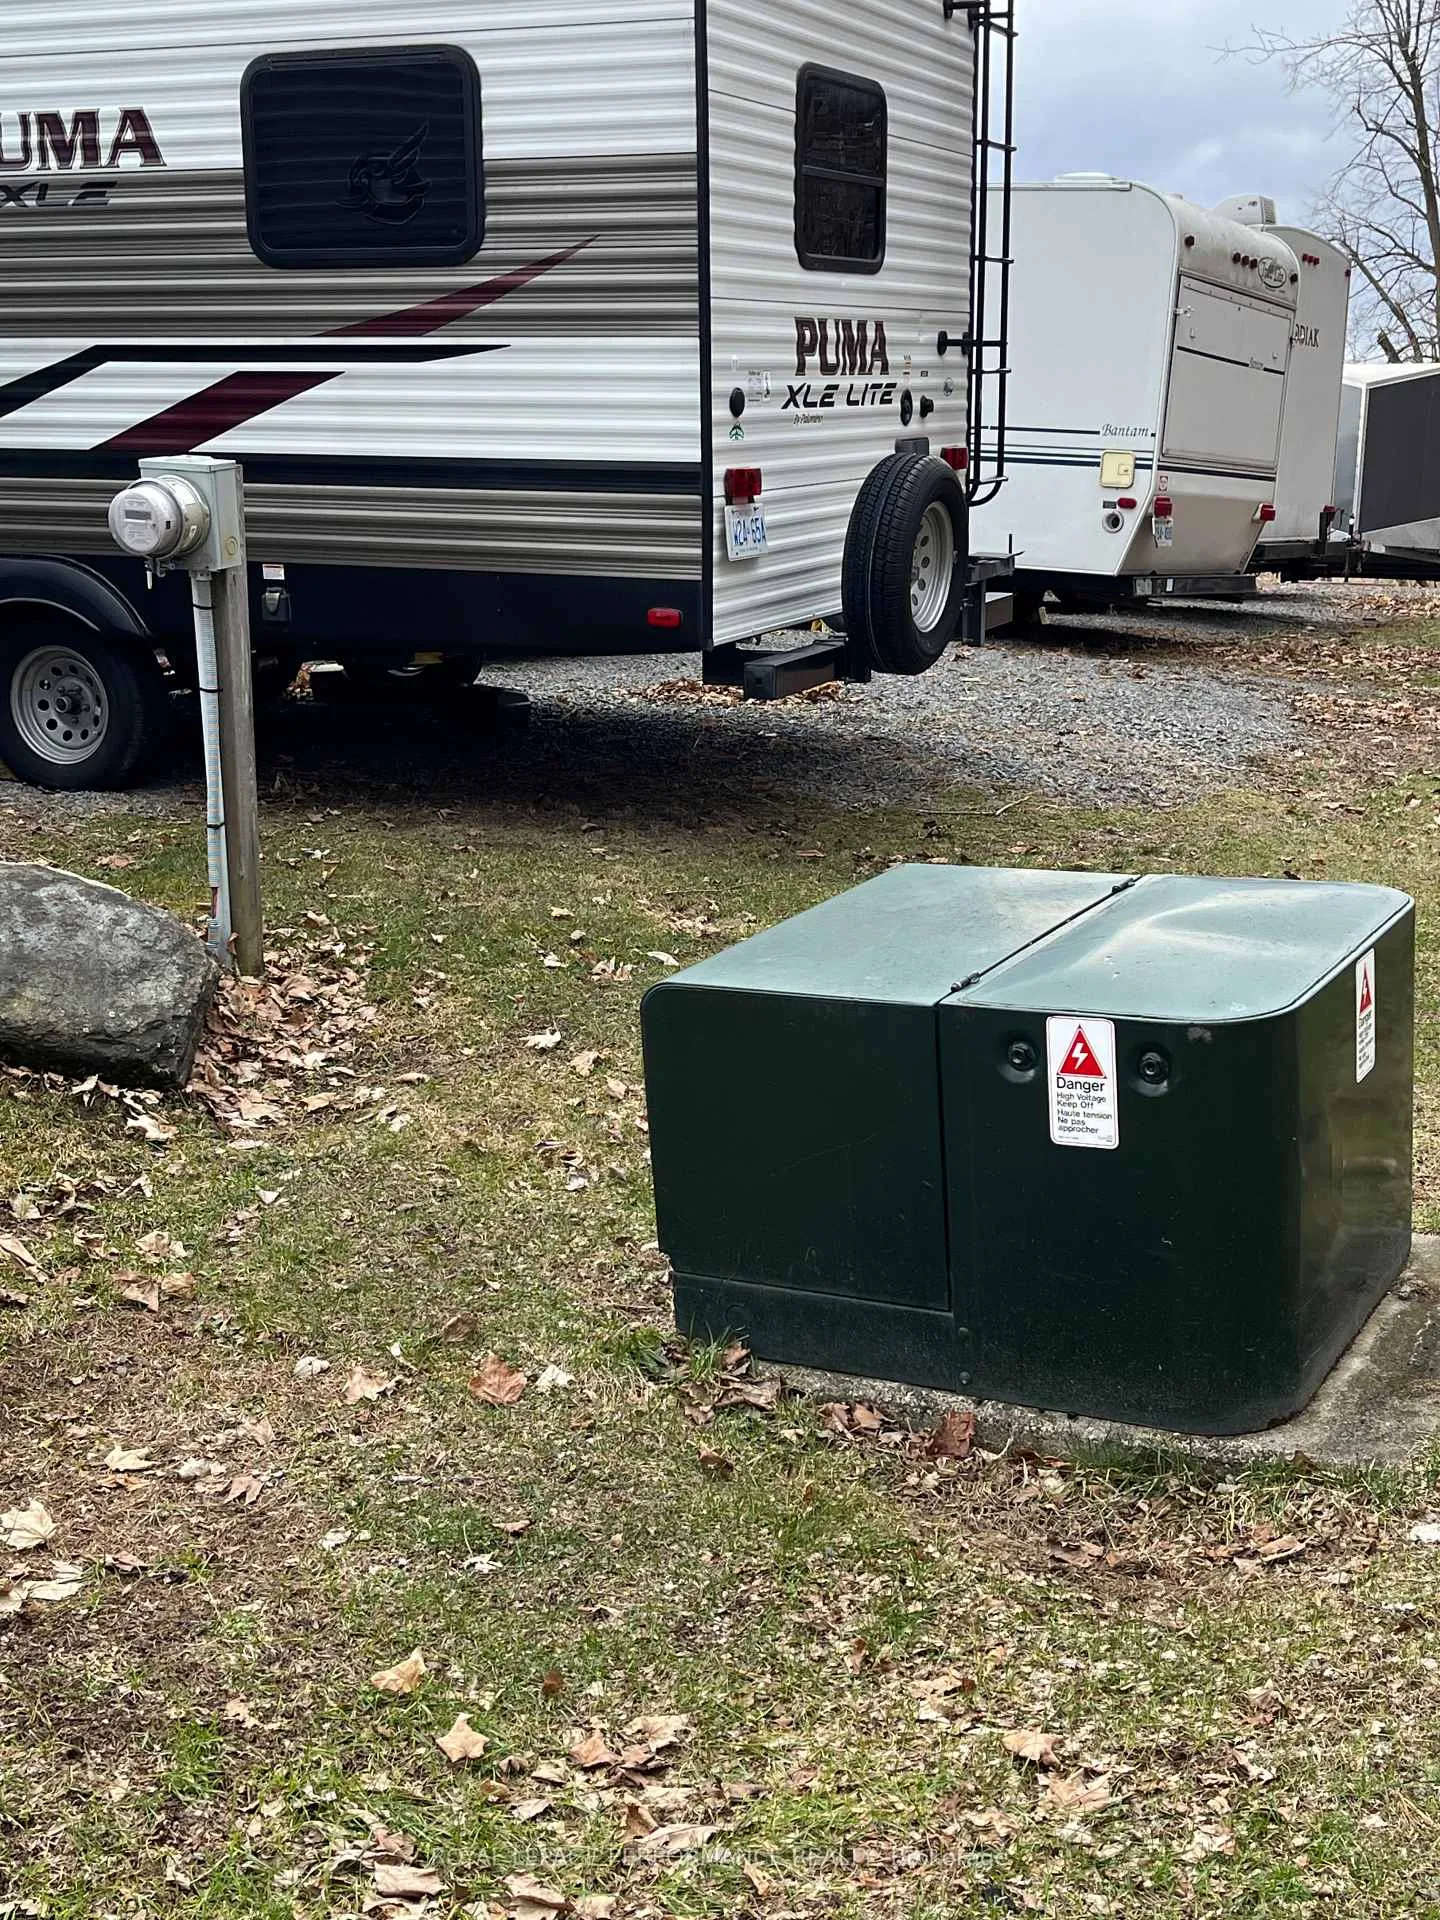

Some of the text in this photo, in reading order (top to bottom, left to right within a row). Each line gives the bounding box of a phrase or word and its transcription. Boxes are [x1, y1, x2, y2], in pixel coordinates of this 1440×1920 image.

[793, 316, 889, 376] PUMA
[781, 382, 840, 410] XLE
[846, 382, 898, 407] LITE
[1101, 423, 1149, 438] Bantam
[1056, 1077, 1105, 1093] Danger
[1057, 1092, 1106, 1103] High Voltage
[1057, 1100, 1094, 1109] Keep Off
[1057, 1109, 1113, 1120] Haute tension
[1071, 1118, 1086, 1126] pas
[1058, 1125, 1099, 1134] approcher
